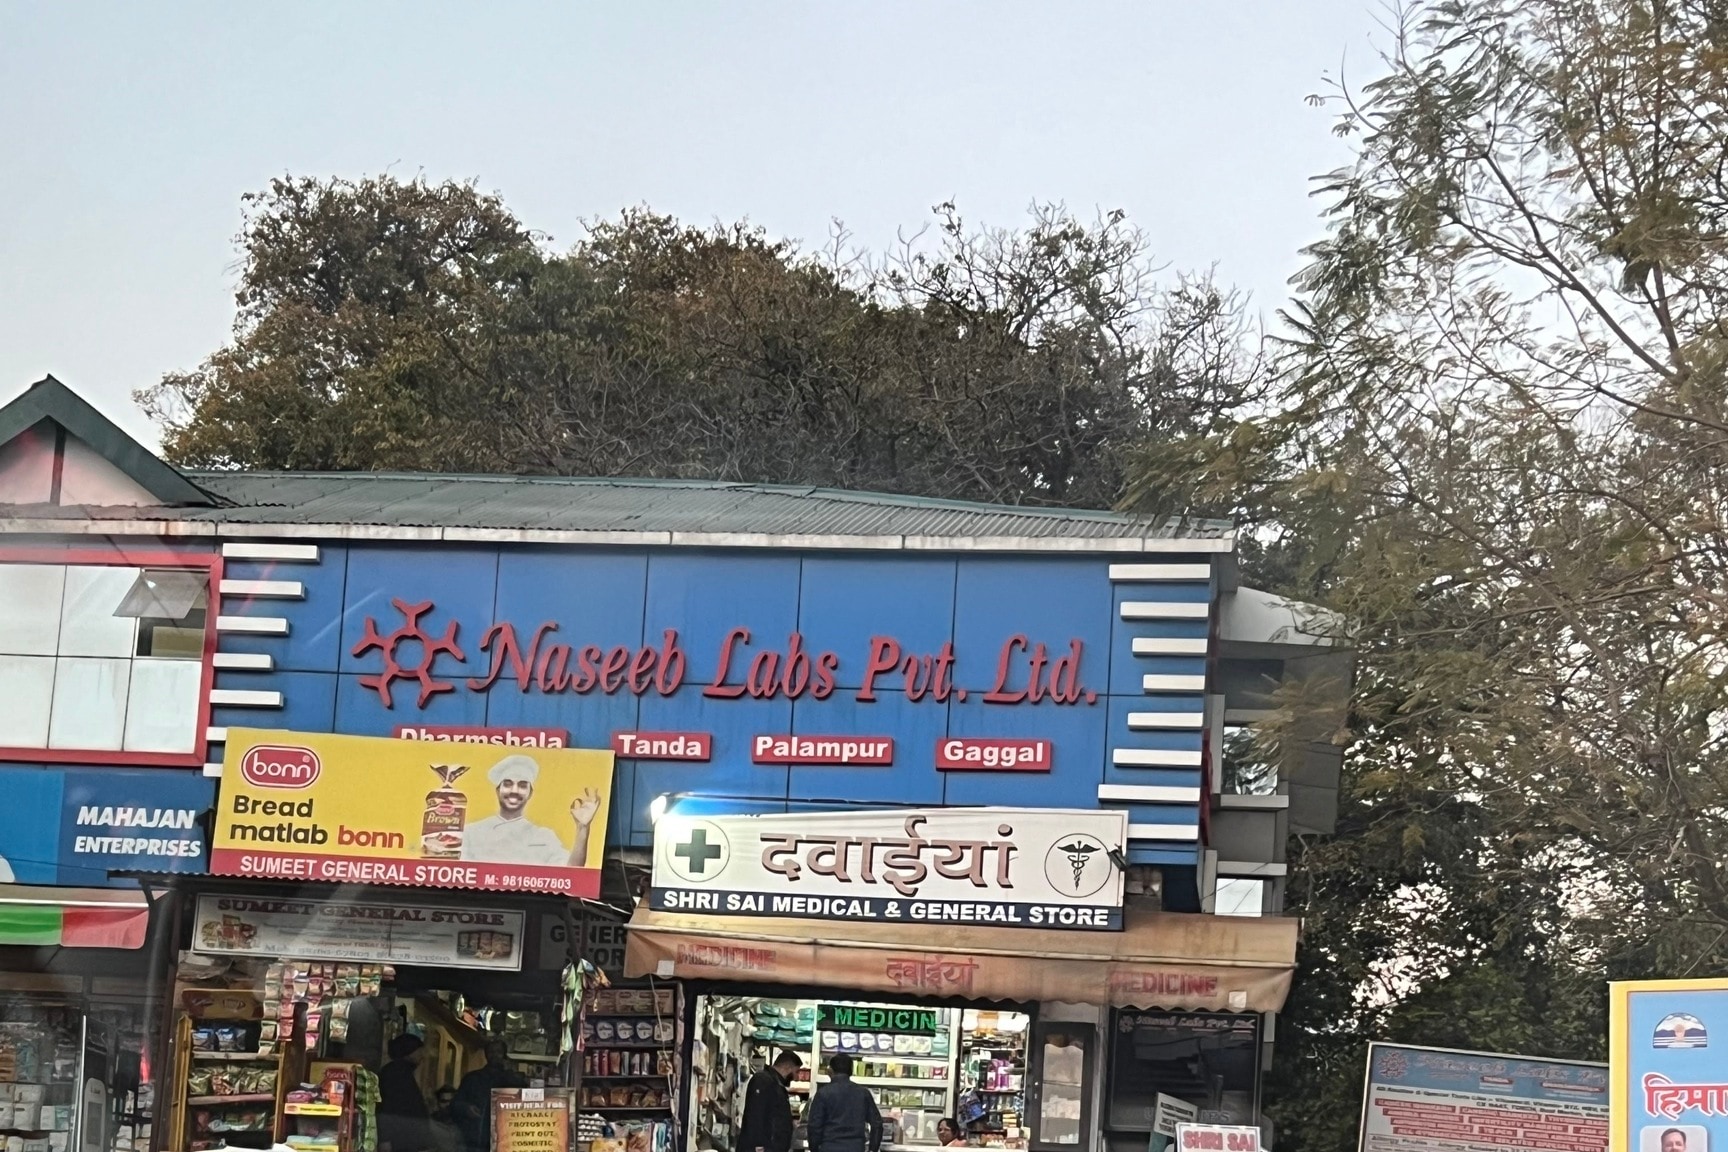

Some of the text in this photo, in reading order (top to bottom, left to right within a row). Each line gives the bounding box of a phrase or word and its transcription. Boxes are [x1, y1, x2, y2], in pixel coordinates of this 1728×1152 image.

[468, 621, 1098, 704] Naseeb Labs Pvt. Ltd.
[618, 735, 702, 756] Tanda
[755, 737, 888, 764] Palampur
[944, 741, 1043, 767] Gaggal
[253, 752, 311, 778] bonn
[76, 806, 196, 830] MAHAJAN
[233, 795, 313, 818] Bread
[74, 837, 201, 858] ENTERPRISES
[230, 823, 404, 848] matlab bonn
[760, 814, 1018, 897] दवाईयां
[240, 856, 317, 876] SUMEET
[321, 860, 410, 881] GENERAL
[415, 863, 477, 885] STORE
[218, 899, 315, 915] SUMEET
[319, 905, 426, 922] GENERAL
[431, 911, 504, 926] STORE
[663, 890, 1110, 926] SHRI SAI MEDICAL & GENERAL STORE
[1110, 970, 1218, 997] MEDICINE
[1183, 1130, 1256, 1152] SHRI SAI
